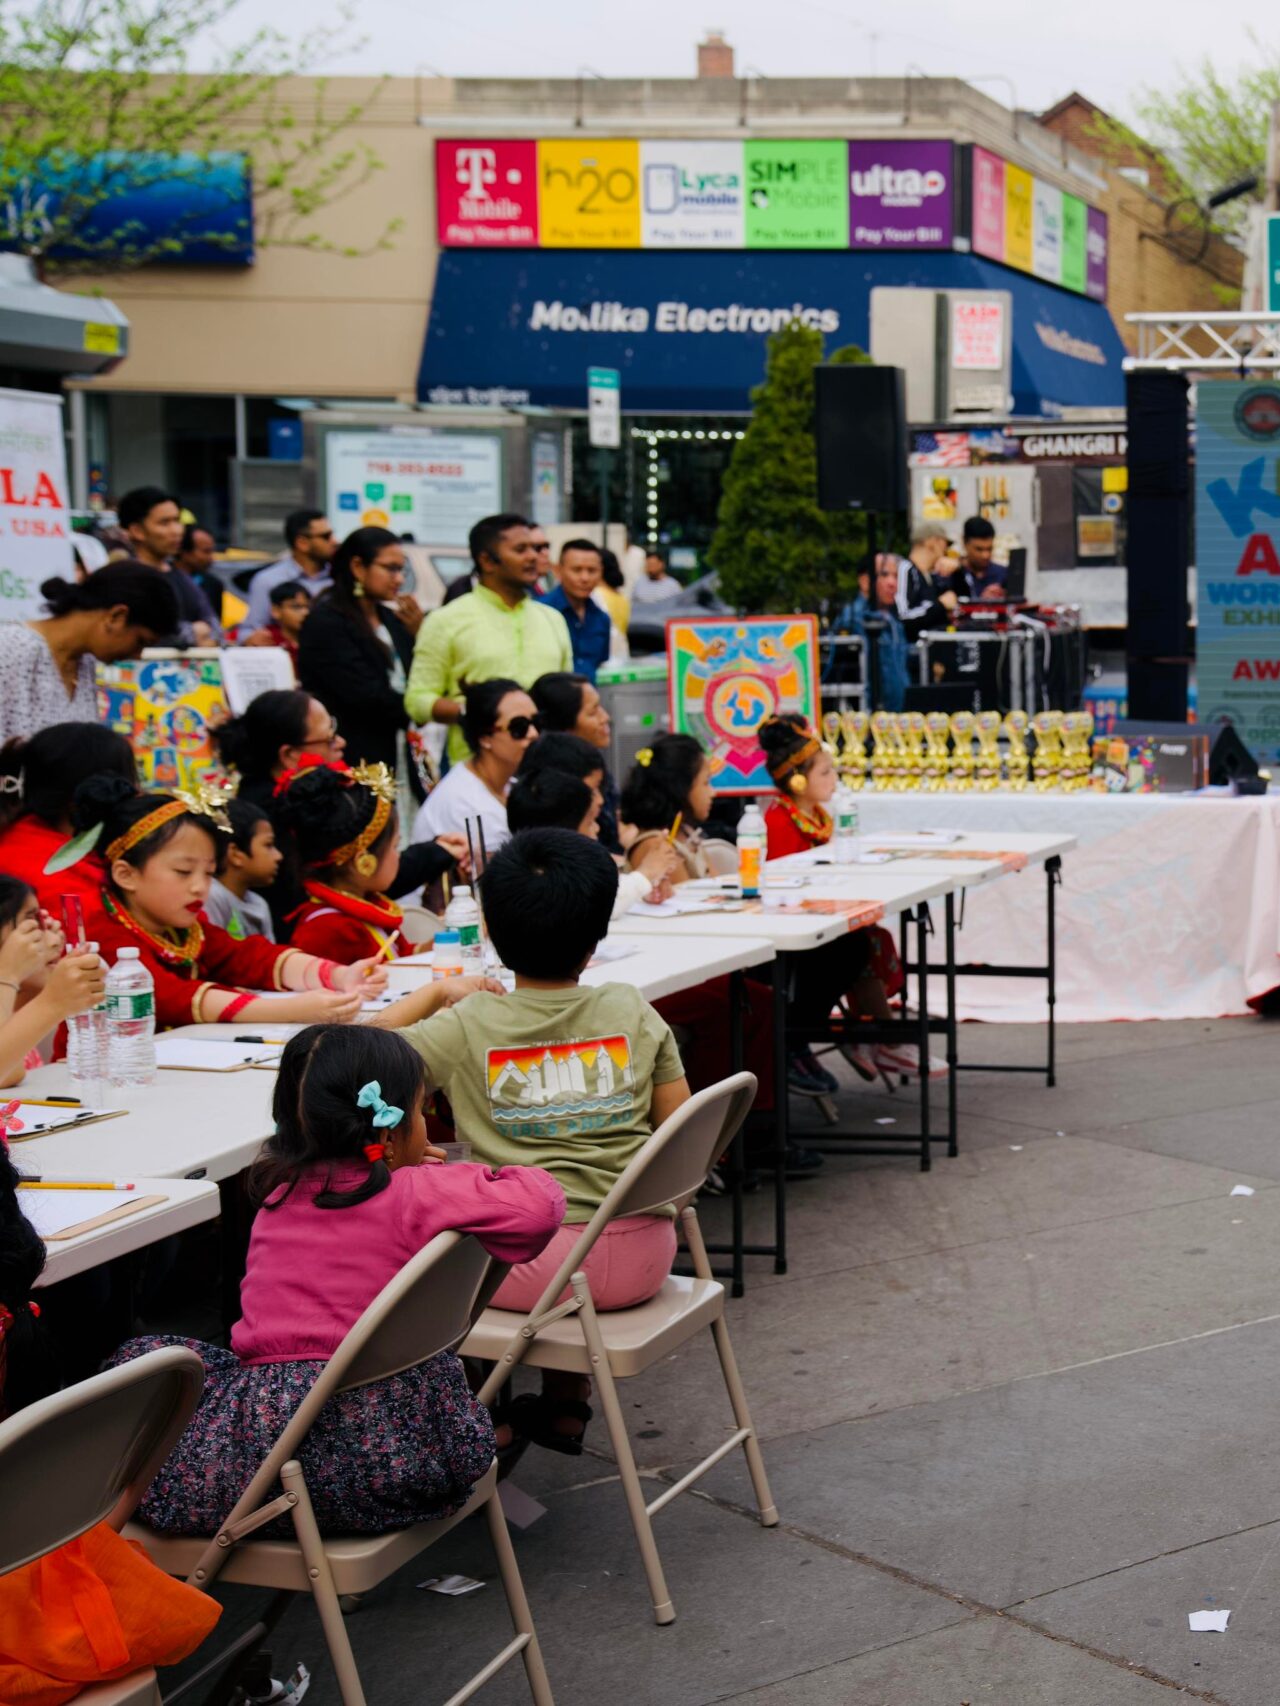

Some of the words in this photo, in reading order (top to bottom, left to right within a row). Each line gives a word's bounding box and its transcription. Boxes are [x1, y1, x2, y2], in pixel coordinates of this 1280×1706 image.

[681, 168, 739, 191] Lyca
[750, 159, 839, 183] SIMPLE
[458, 197, 522, 219] Mobile
[855, 227, 882, 244] Pay
[882, 227, 914, 242] Your
[916, 227, 942, 242] Bill
[654, 301, 840, 333] Electronics
[11, 517, 67, 539] USA
[496, 1121, 558, 1137] VIBES
[567, 1110, 633, 1132] AHEAD
